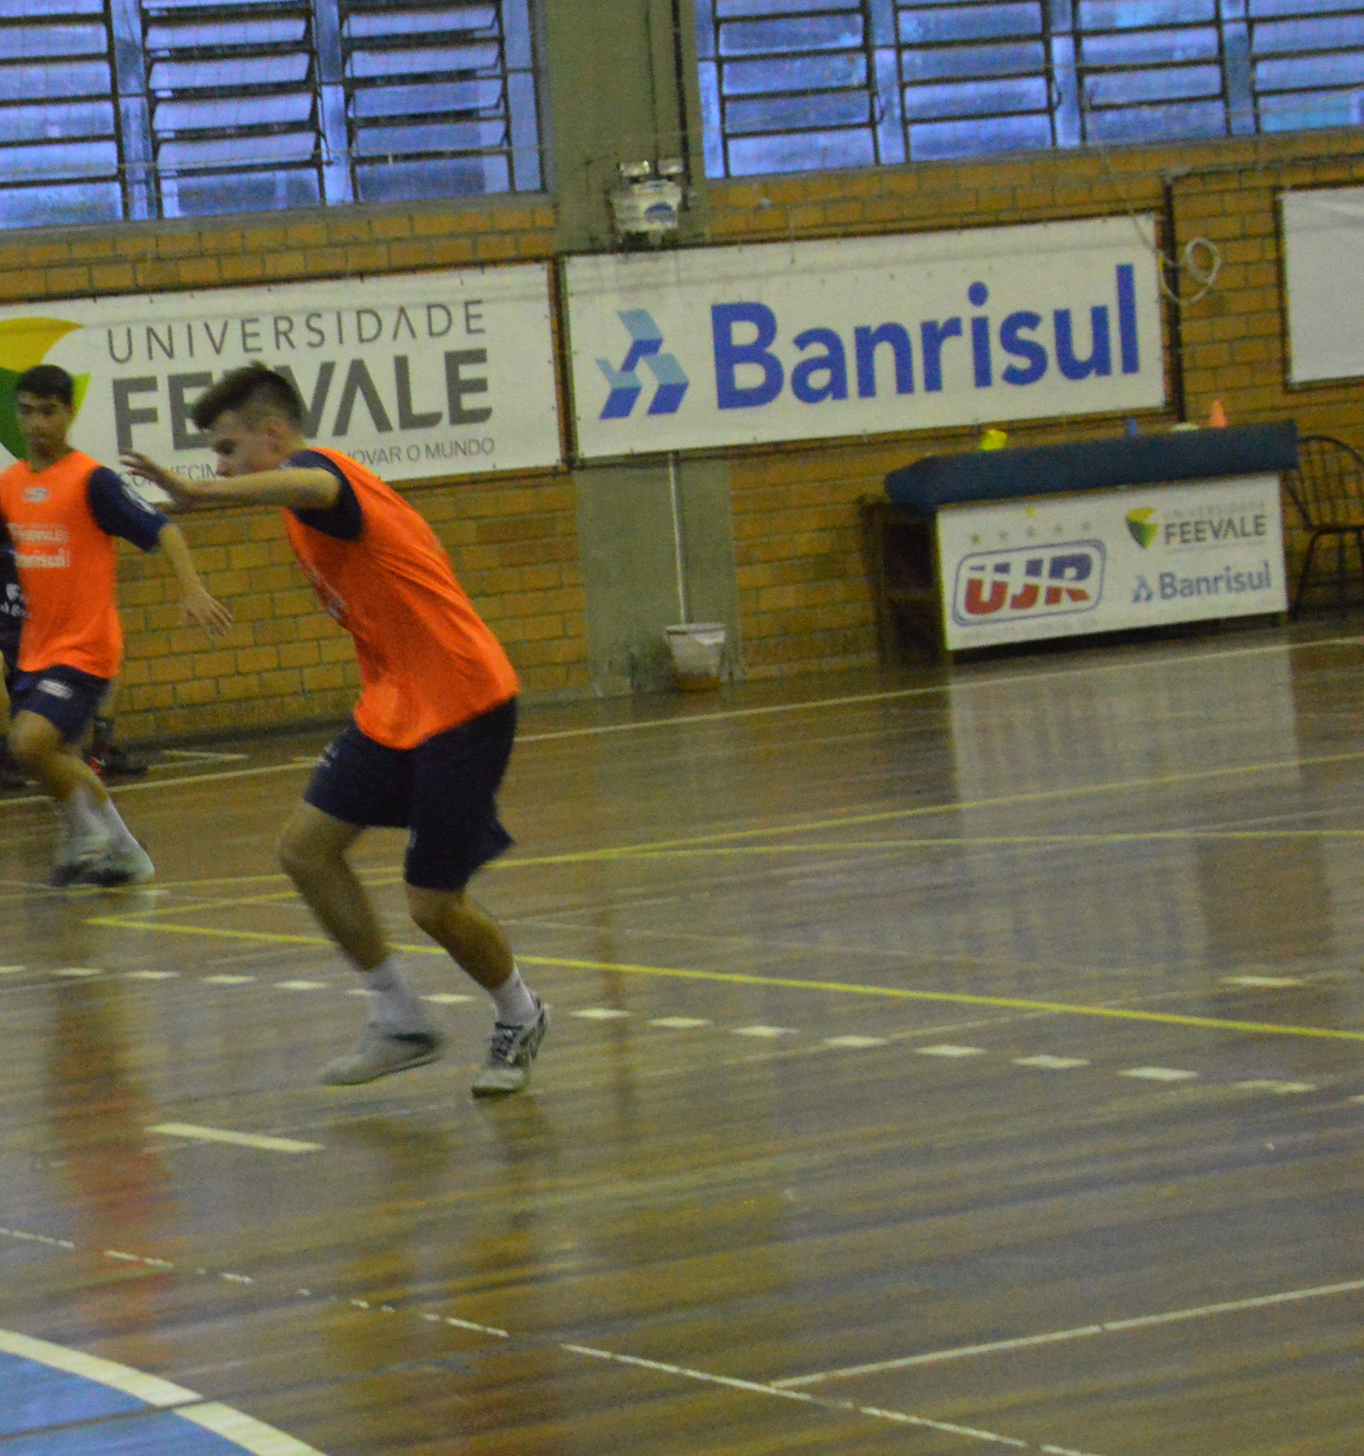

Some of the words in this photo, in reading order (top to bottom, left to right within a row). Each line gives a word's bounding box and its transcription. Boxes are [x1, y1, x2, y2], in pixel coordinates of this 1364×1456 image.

[108, 300, 486, 364] UNIVERSIDADE
[710, 263, 1140, 411] Banrisul
[112, 348, 493, 456] FEVALE
[406, 443, 421, 462] O
[424, 437, 496, 460] MUNDO
[1164, 514, 1267, 544] FEEVALE
[964, 553, 1093, 615] UJR
[1159, 559, 1272, 600] Banrisul
